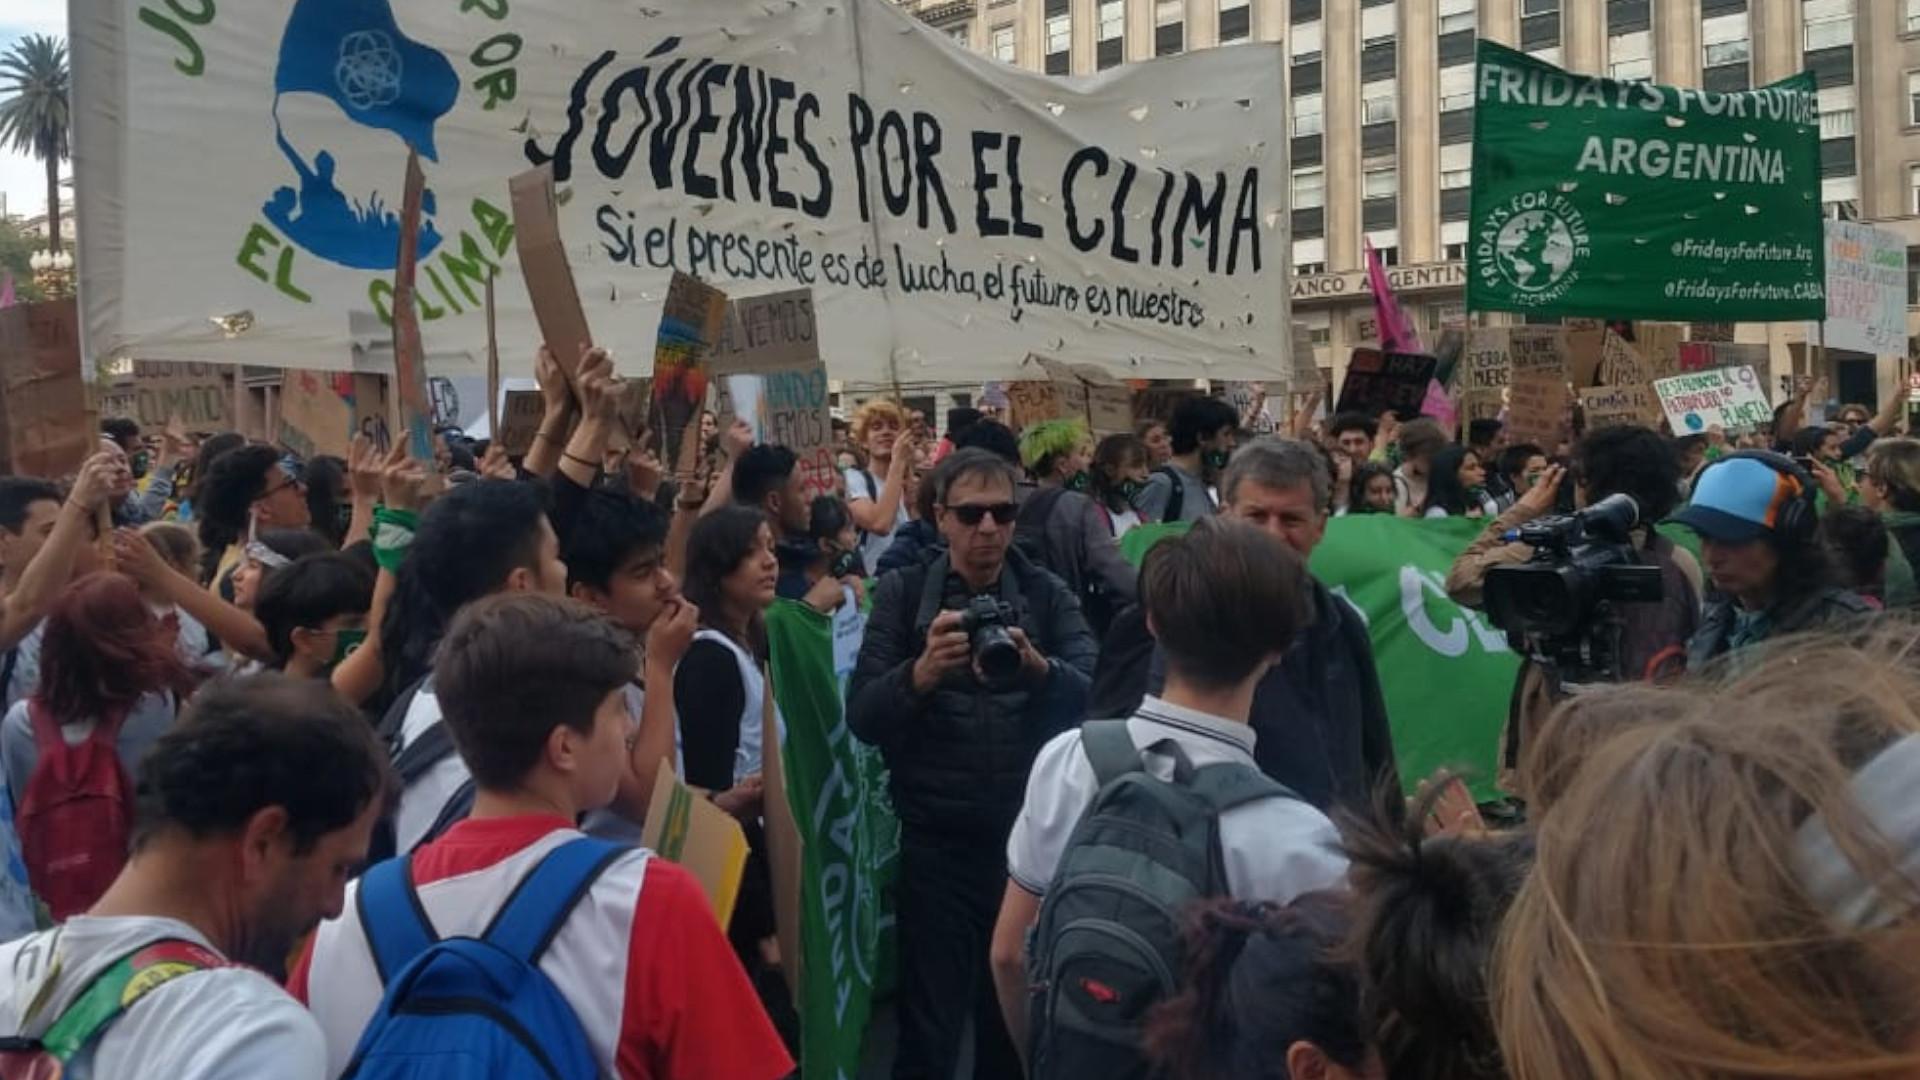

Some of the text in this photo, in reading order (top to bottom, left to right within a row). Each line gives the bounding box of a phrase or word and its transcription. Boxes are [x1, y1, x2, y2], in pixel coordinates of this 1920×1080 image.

[1478, 63, 1666, 112] FRIDAYS
[524, 36, 1261, 275] JÓVENES POR EL CLIMA
[1576, 135, 1785, 184] ARGENTINA
[236, 222, 312, 303] EL
[597, 204, 640, 268] Si
[645, 218, 676, 269] el
[688, 226, 815, 284] presente
[821, 251, 851, 286] es
[855, 245, 887, 289] de
[983, 263, 1002, 299] el
[1010, 265, 1079, 322] futuro
[1086, 285, 1112, 316] es
[1477, 190, 1591, 288] FRIDAYS FOR FUTURE
[1290, 277, 1345, 296] ANCO
